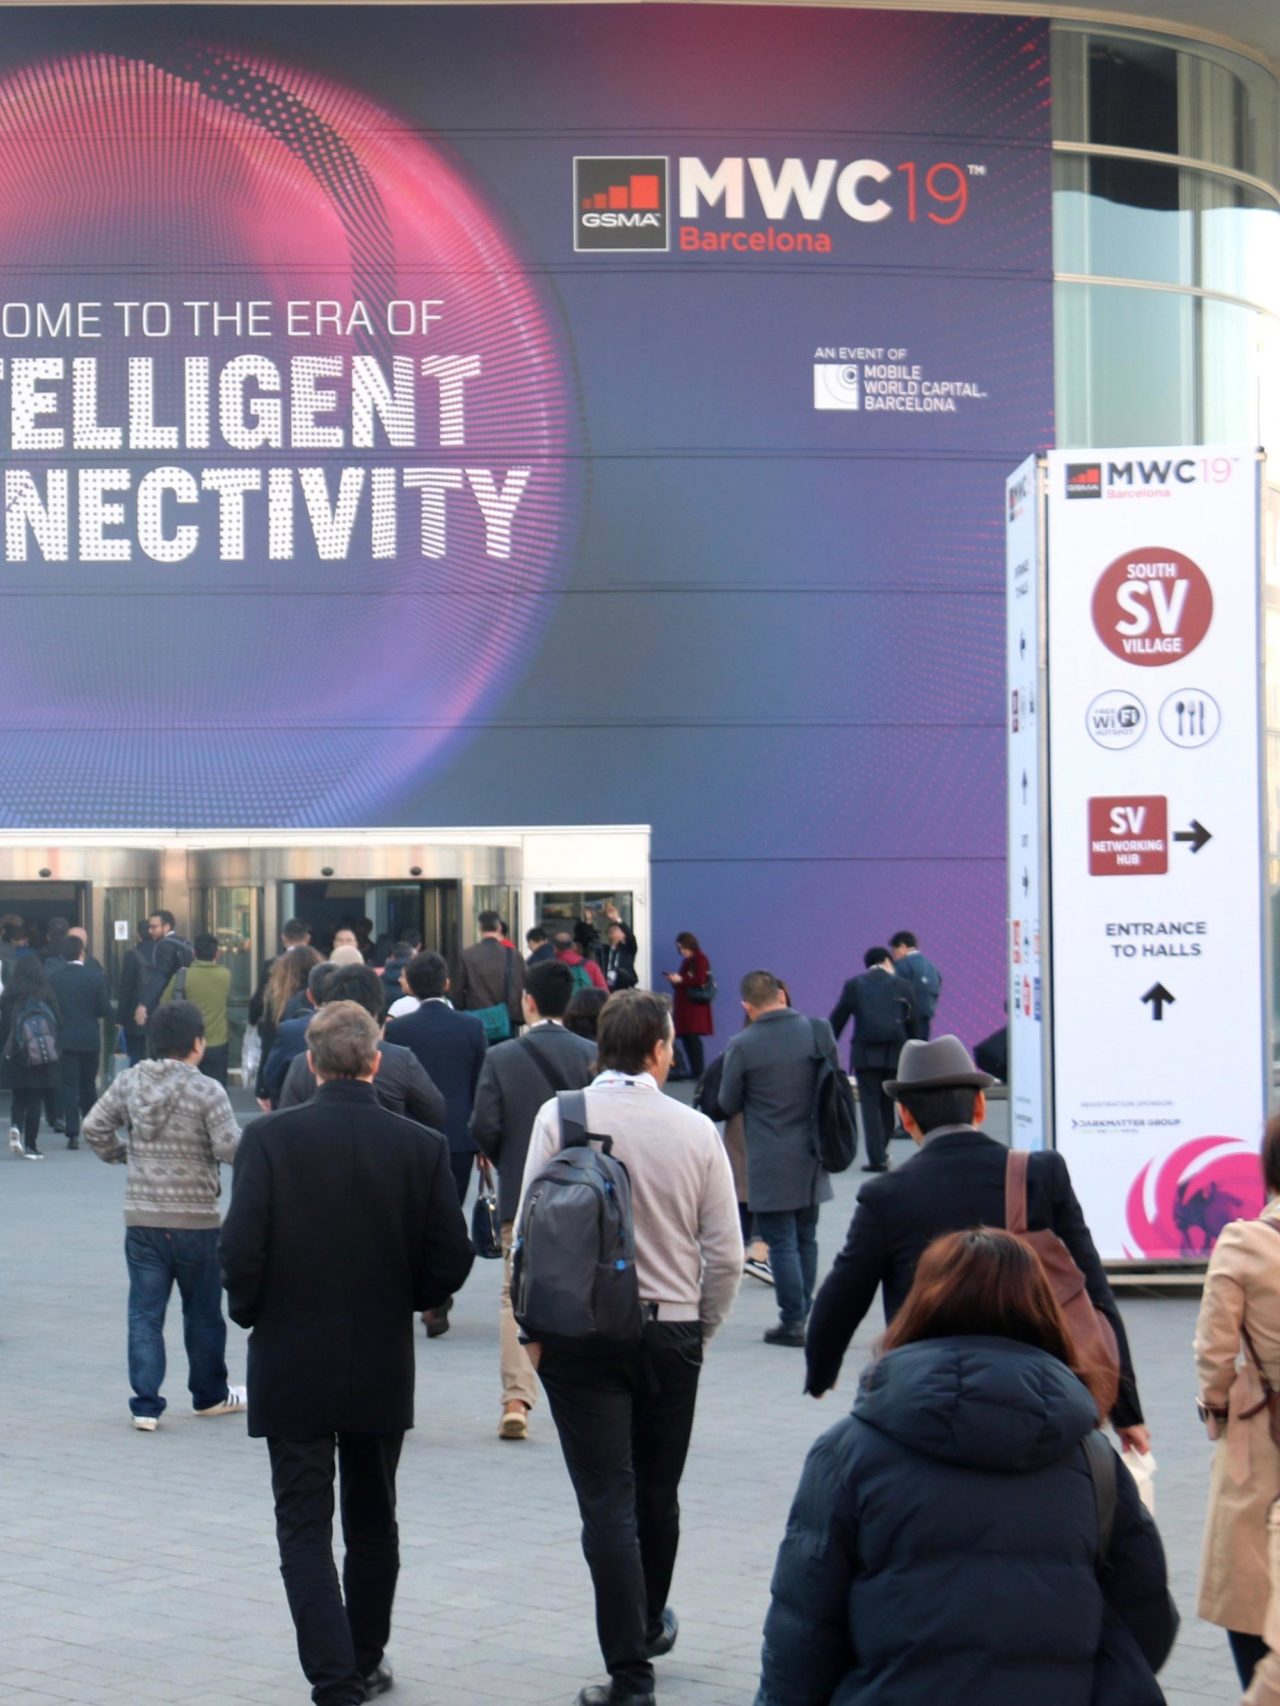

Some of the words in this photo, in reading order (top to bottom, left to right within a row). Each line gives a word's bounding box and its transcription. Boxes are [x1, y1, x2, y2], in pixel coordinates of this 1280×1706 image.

[581, 212, 660, 228] GSMA
[678, 226, 832, 252] Barcelona
[113, 301, 171, 338] TO
[184, 301, 272, 337] THE
[287, 300, 376, 336] ERA
[386, 299, 444, 336] OF
[814, 347, 835, 359] AN
[838, 347, 883, 360] EVENT
[887, 348, 907, 360] OF
[864, 365, 922, 380] MOBILE
[864, 380, 918, 396] WORLD
[921, 382, 981, 397] CAPITAL
[864, 396, 956, 412] BARCELONA
[1106, 488, 1170, 499] Barcelona
[1126, 562, 1177, 579] SOUTH
[1114, 579, 1190, 636] SV
[1122, 637, 1183, 653] VILLAGE
[1110, 806, 1146, 835] SV
[1092, 839, 1163, 852] NETWORKING
[1116, 854, 1141, 865] HUB
[1106, 921, 1206, 936] ENTRANCE
[1111, 944, 1136, 958] TO
[1142, 943, 1201, 957] HALLS
